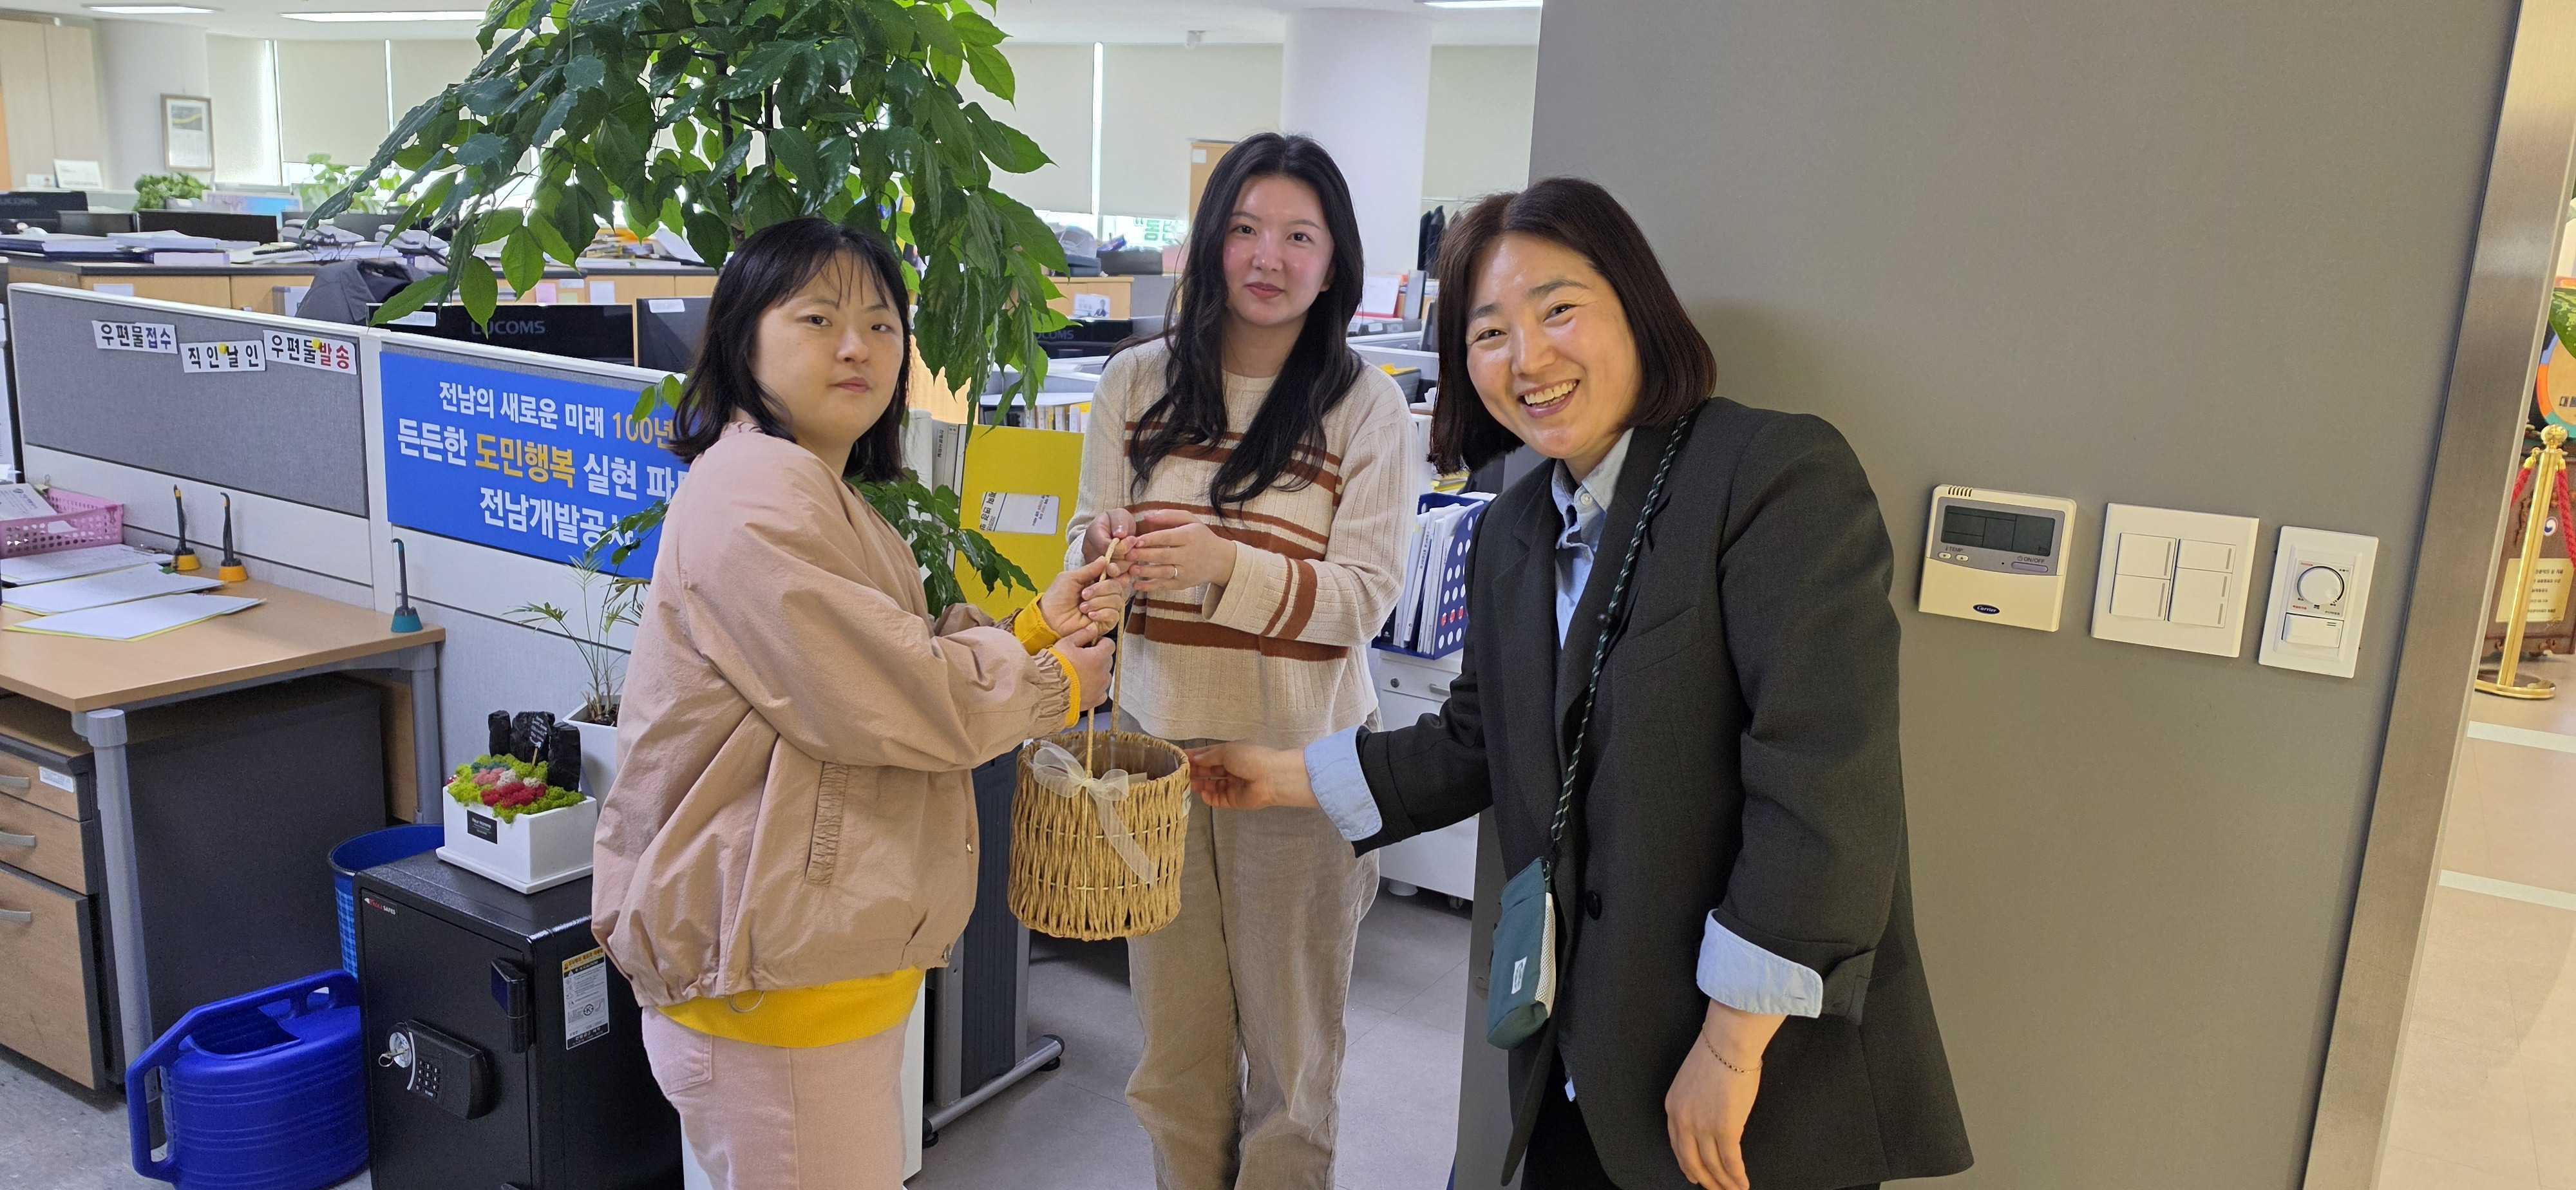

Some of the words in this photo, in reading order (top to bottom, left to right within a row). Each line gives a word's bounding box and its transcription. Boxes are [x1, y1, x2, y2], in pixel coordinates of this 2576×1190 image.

[101, 323, 171, 350] 우편물접수
[471, 320, 546, 335] LUCOMS
[439, 381, 494, 419] 전남의
[500, 392, 558, 430] 새로운
[565, 404, 604, 439] 미래
[612, 411, 676, 449] 100년
[397, 418, 468, 466] 든든한
[475, 432, 576, 489] 도민행복
[583, 453, 637, 500] 실현
[647, 466, 690, 505] 파
[2023, 556, 2045, 565] ON/OFF
[1977, 605, 1997, 613] Carrier
